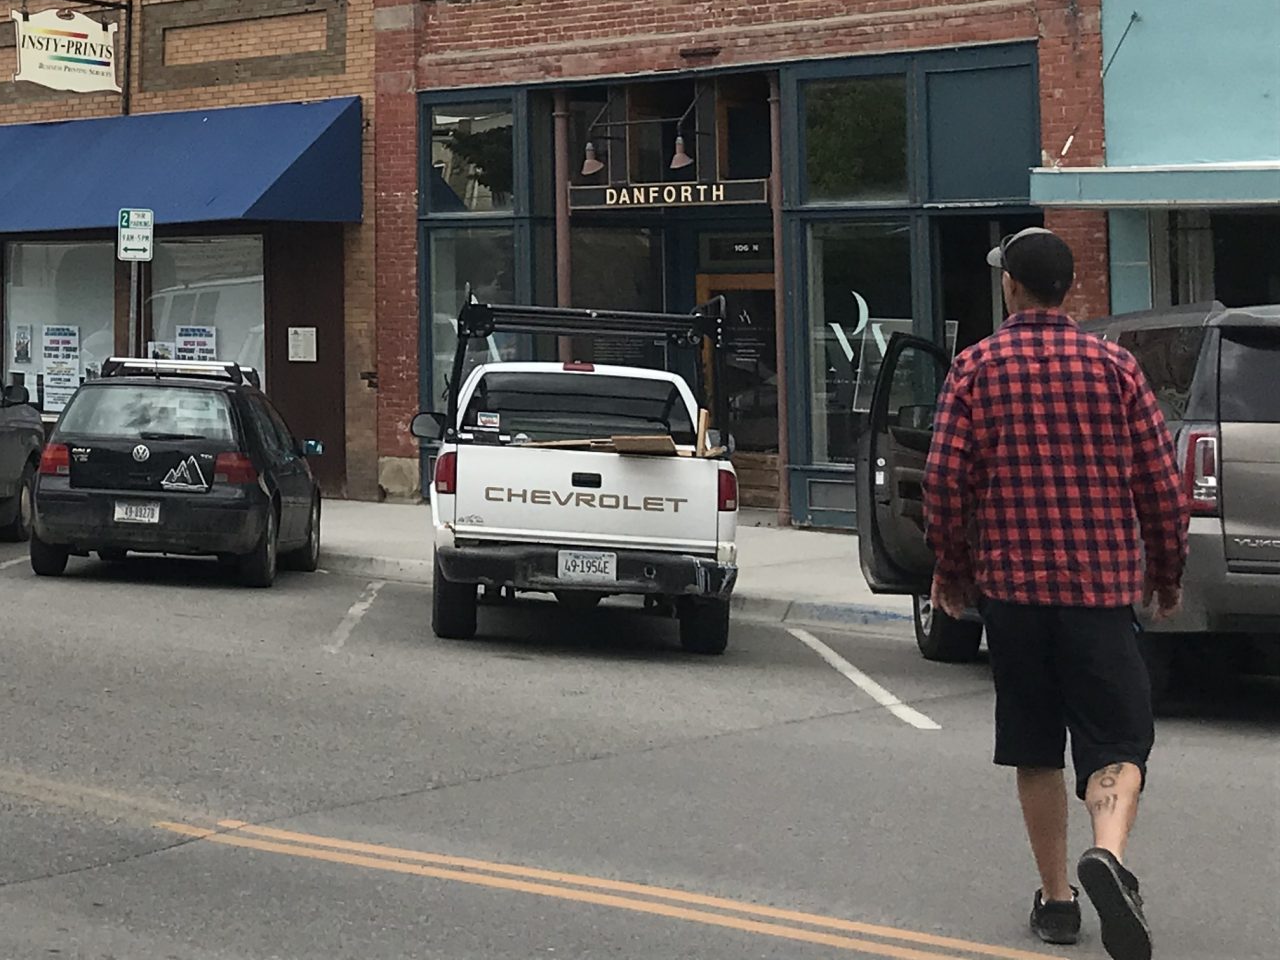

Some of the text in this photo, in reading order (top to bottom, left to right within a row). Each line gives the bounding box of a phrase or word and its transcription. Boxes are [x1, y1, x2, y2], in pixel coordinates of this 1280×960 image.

[22, 34, 113, 58] INSTY-PRINTS
[606, 184, 724, 205] DANFORTH
[122, 213, 129, 226] 2
[734, 244, 749, 252] 106
[484, 486, 688, 513] CHEVROLET
[564, 559, 610, 574] 49-1954E
